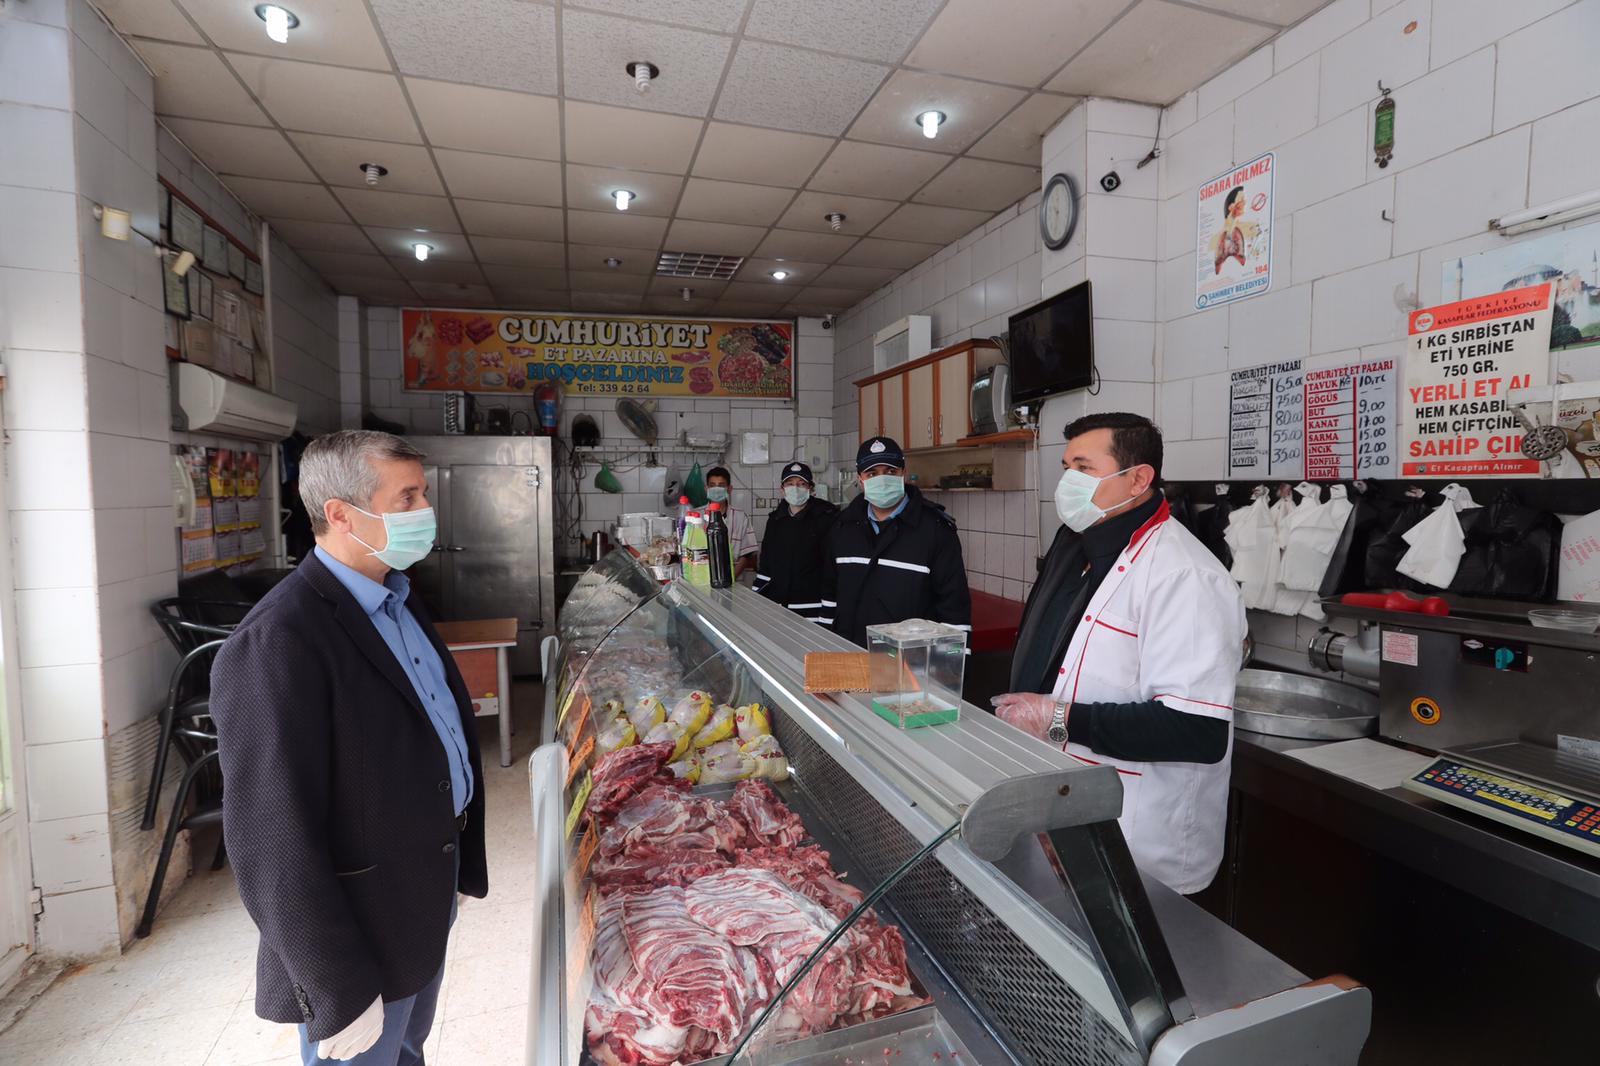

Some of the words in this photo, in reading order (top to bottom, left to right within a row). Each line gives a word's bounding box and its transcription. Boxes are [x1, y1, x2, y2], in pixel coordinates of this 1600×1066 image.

[1200, 176, 1230, 200] SİGARA
[1233, 158, 1271, 187] İÇİLMEZ
[1255, 264, 1268, 274] 184
[1438, 313, 1475, 325] KASAPLAR
[1477, 300, 1541, 318] FEDERASYONU
[1417, 339, 1422, 349] 1
[1427, 334, 1446, 348] KG
[1451, 318, 1535, 344] SIRBİSTAN
[543, 347, 568, 361] ET
[573, 348, 668, 364] PAZARINA
[1431, 347, 1452, 363] ETİ
[1458, 339, 1514, 359] YERİNE
[1269, 365, 1277, 375] ET
[1277, 360, 1301, 373] PAZARI
[1350, 365, 1360, 375] ET
[1362, 360, 1393, 373] PAZARI
[1443, 364, 1468, 377] 750
[1473, 360, 1498, 374] GR.
[577, 383, 595, 392] Tel:
[599, 384, 618, 393] 339
[621, 384, 634, 393] 42
[637, 384, 649, 393] 64
[1308, 380, 1338, 391] TAVUK
[1409, 379, 1466, 404] YERLİ
[1474, 378, 1501, 397] ET
[1309, 408, 1325, 417] BUT
[1359, 399, 1385, 414] 9.00
[1416, 406, 1444, 419] HEM
[1450, 400, 1527, 417] KASABI
[1309, 419, 1339, 429] KANAT
[1418, 422, 1447, 434] HEM
[1452, 415, 1521, 435] ÇİFTÇİNE
[1309, 433, 1339, 442] SARMA
[1359, 427, 1386, 441] 15.00
[1409, 435, 1479, 457] SAHİP
[1358, 455, 1390, 469] 13.00
[1444, 464, 1490, 473] Kasaptan
[1493, 463, 1523, 472] Alınır
